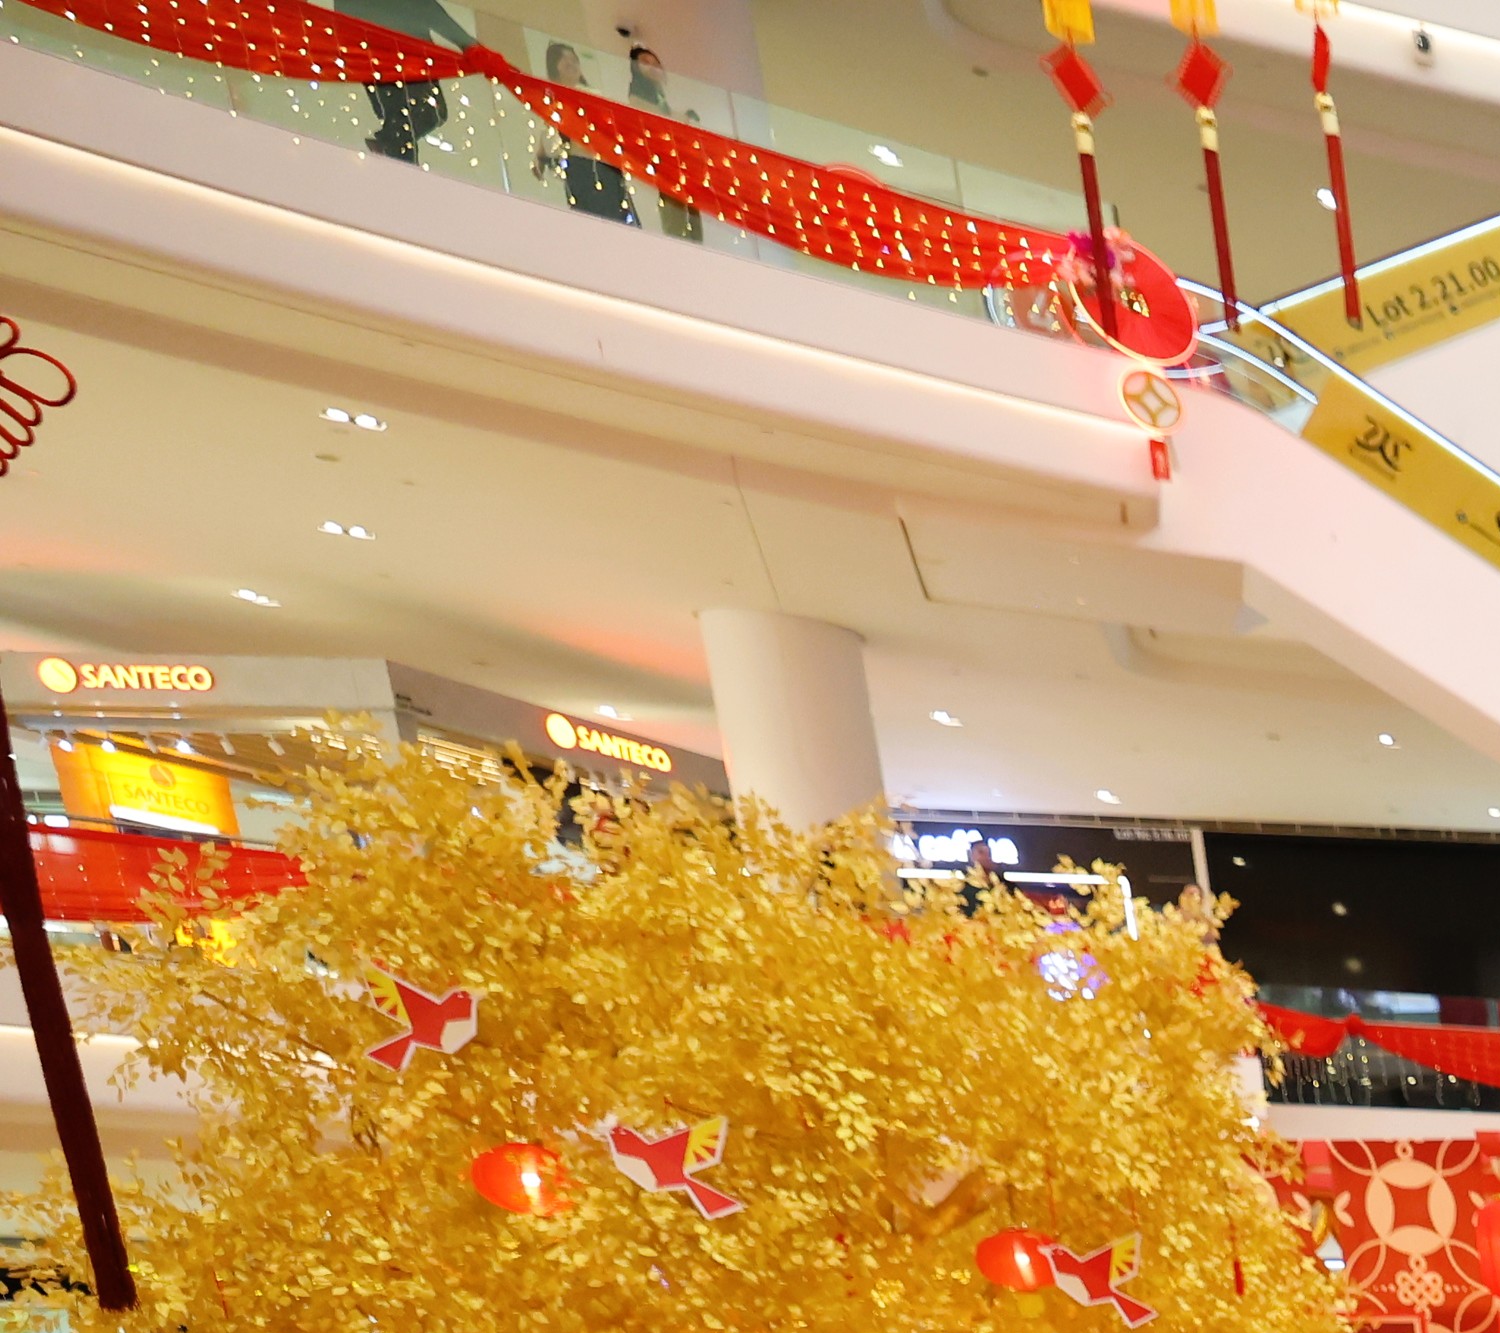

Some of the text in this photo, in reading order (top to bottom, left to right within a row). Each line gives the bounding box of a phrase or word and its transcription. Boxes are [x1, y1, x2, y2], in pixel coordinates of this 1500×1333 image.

[1365, 294, 1410, 330] Lot
[83, 663, 216, 692] SANTECO
[577, 725, 673, 773] SANTECO
[126, 783, 211, 815] SANTECO
